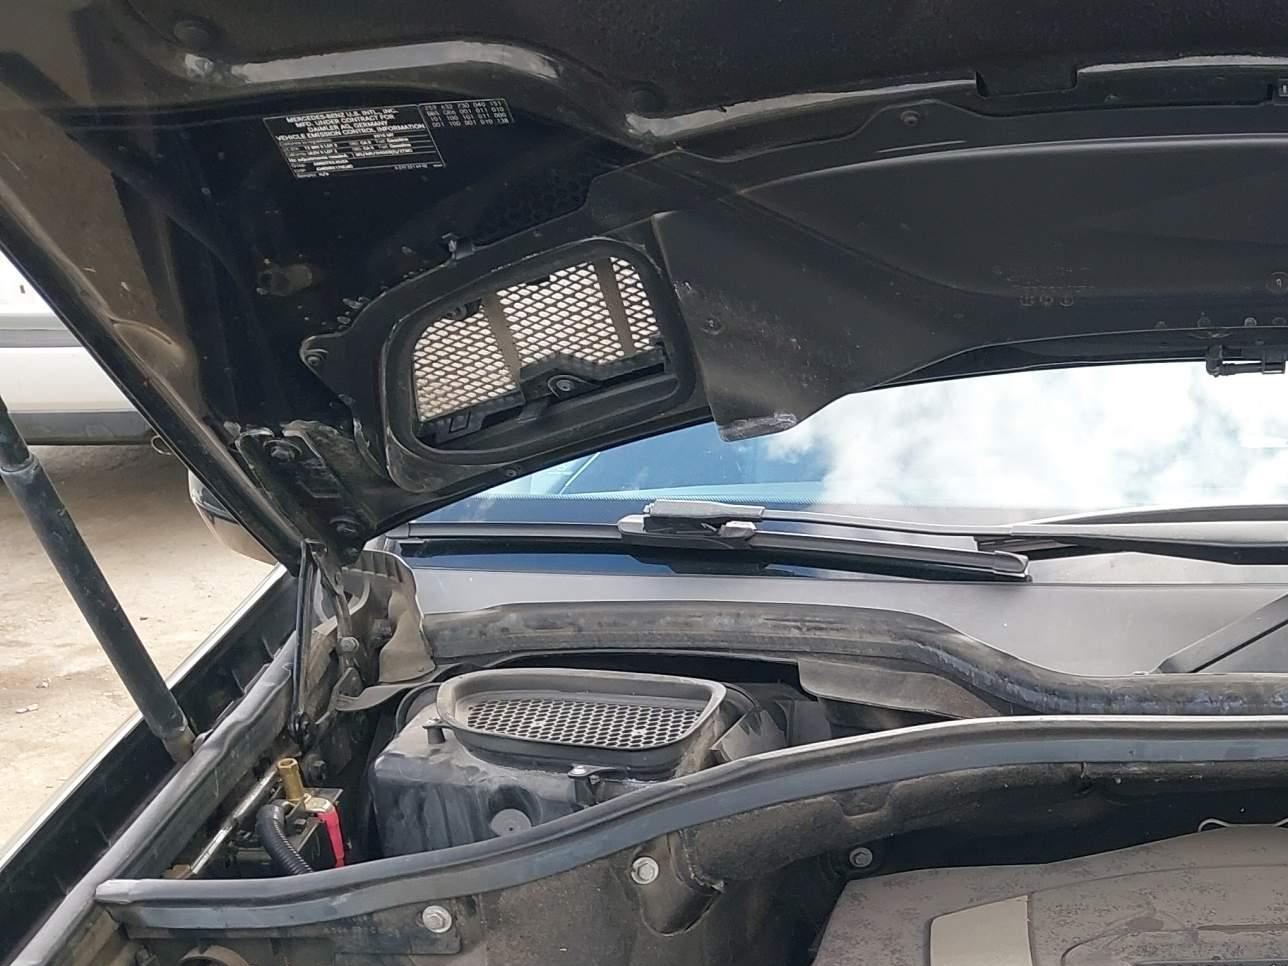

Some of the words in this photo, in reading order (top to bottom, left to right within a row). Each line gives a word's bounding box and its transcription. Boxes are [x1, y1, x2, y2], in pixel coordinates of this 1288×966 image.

[314, 118, 340, 126] UNDER
[341, 115, 379, 123] CONTRACT
[353, 120, 388, 128] GERMANY
[307, 131, 341, 139] EMISSION
[342, 128, 376, 136] CONTROL
[377, 123, 425, 132] INFORMATION
